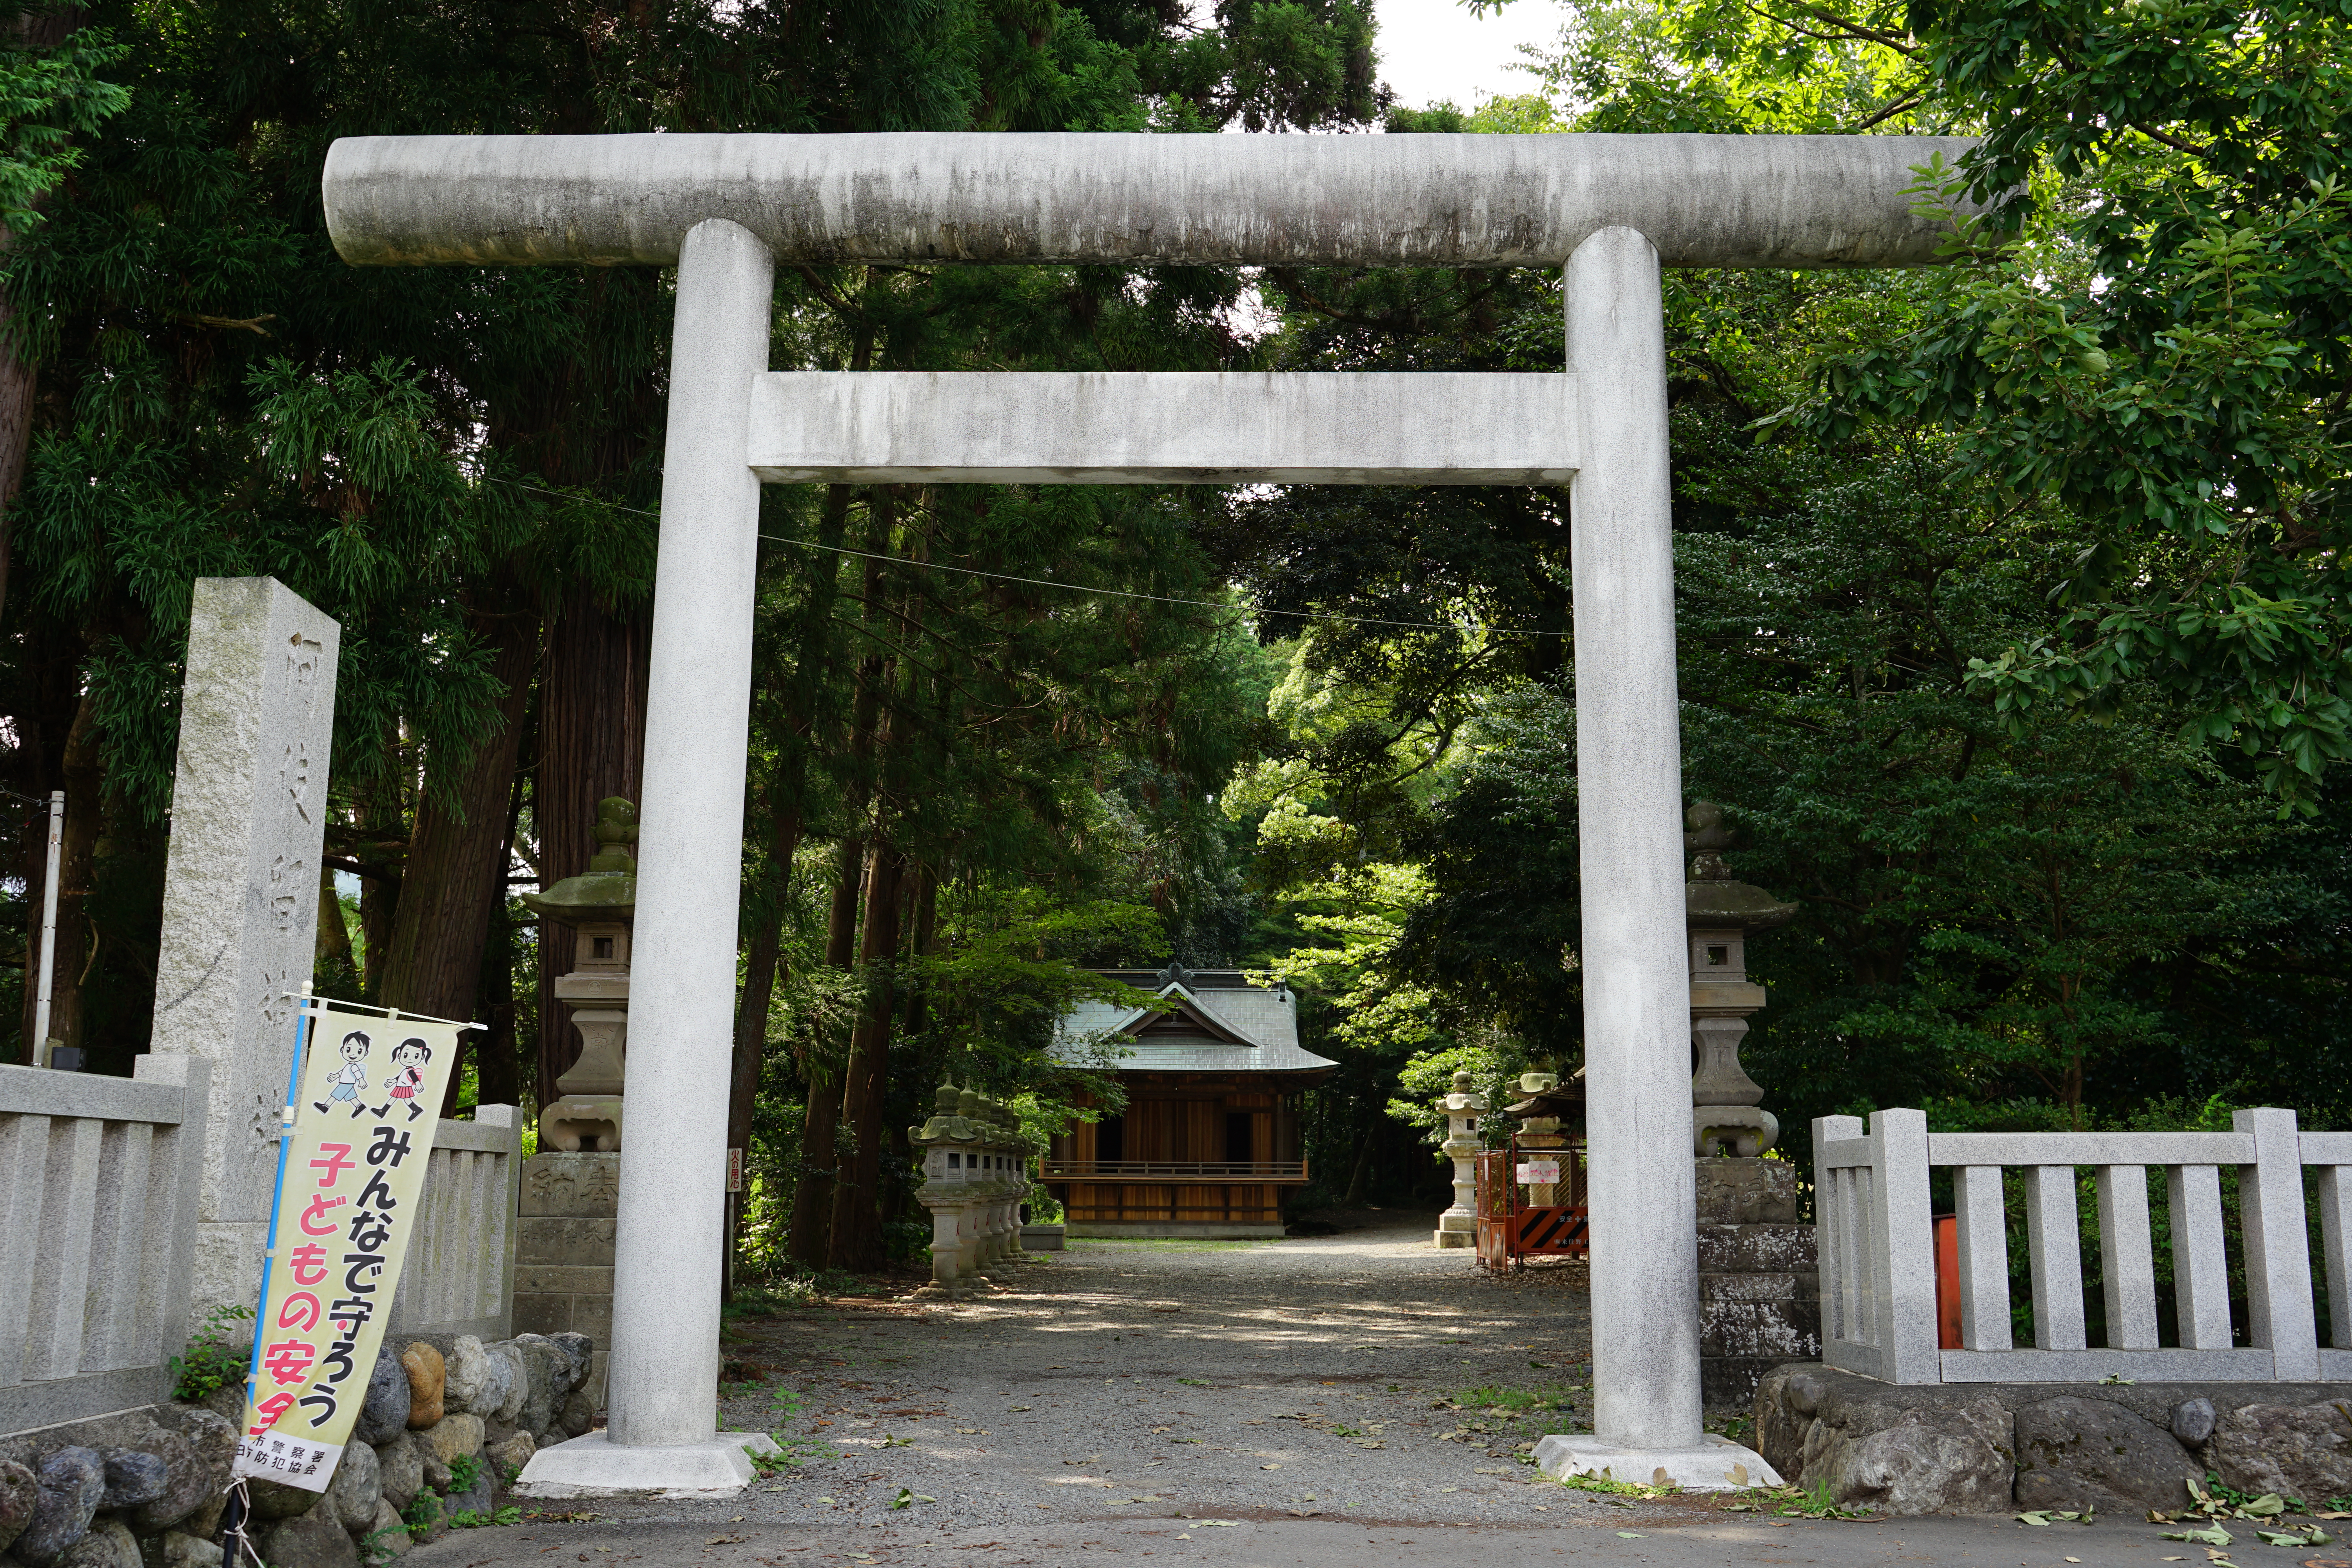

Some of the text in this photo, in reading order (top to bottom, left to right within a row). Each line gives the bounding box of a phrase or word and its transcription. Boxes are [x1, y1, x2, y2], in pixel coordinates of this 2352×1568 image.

[730, 1150, 740, 1189] 火の用心
[299, 1127, 411, 1428] みんなで守ろう
